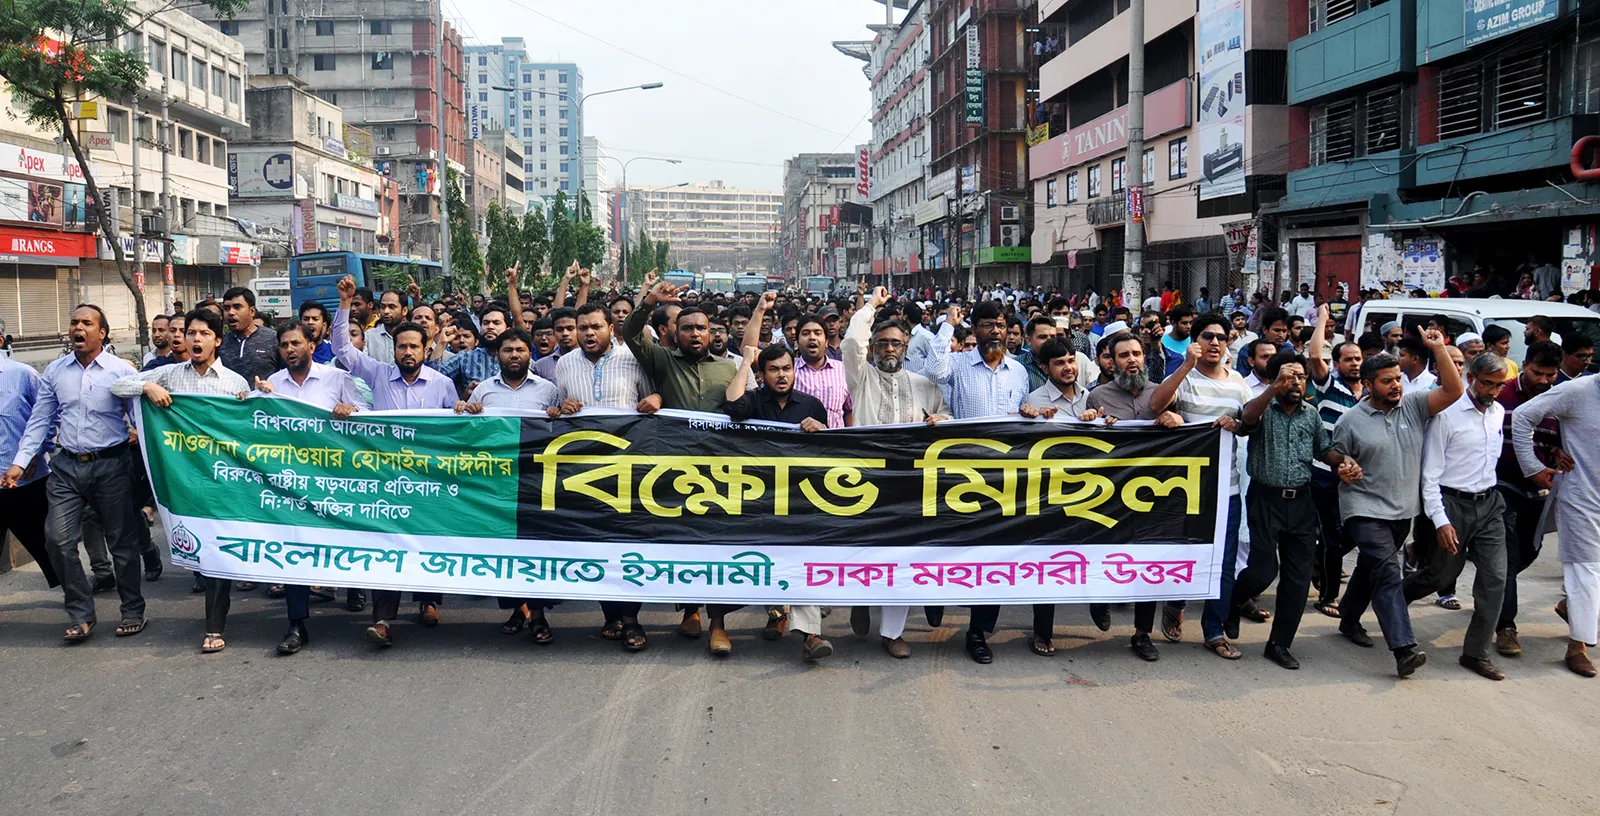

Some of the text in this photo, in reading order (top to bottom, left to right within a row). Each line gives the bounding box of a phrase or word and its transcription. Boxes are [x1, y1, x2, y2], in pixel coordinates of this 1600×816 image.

[1486, 12, 1510, 31] AZIM
[1511, 1, 1546, 22] GROUP
[88, 135, 111, 146] Apex
[1075, 114, 1126, 156] TANIN
[18, 148, 45, 174] Apex
[857, 148, 869, 199] Bata
[253, 409, 327, 433] বিশ্ববরেণ্য
[330, 419, 387, 438] আলেমে
[246, 442, 345, 468] দেলাওয়ার
[352, 447, 432, 474] হোসাইন
[212, 460, 264, 485] বিরুদ্ধে
[315, 475, 381, 495] ষড়যন্ত্রের
[384, 475, 442, 497] প্রতিবাদ
[447, 483, 459, 497] ও
[533, 430, 1210, 529] বিক্ষোভ মিছিল
[311, 496, 355, 518] মুক্তির
[359, 499, 413, 520] দাবিতে
[216, 535, 408, 573] বাংলাদেশ
[420, 550, 609, 583] জামায়াতে
[620, 551, 790, 591] ইসলামী,
[803, 561, 899, 588] ঢাকা
[910, 550, 1091, 589] মহানগরী
[1102, 551, 1197, 585] উত্তর
